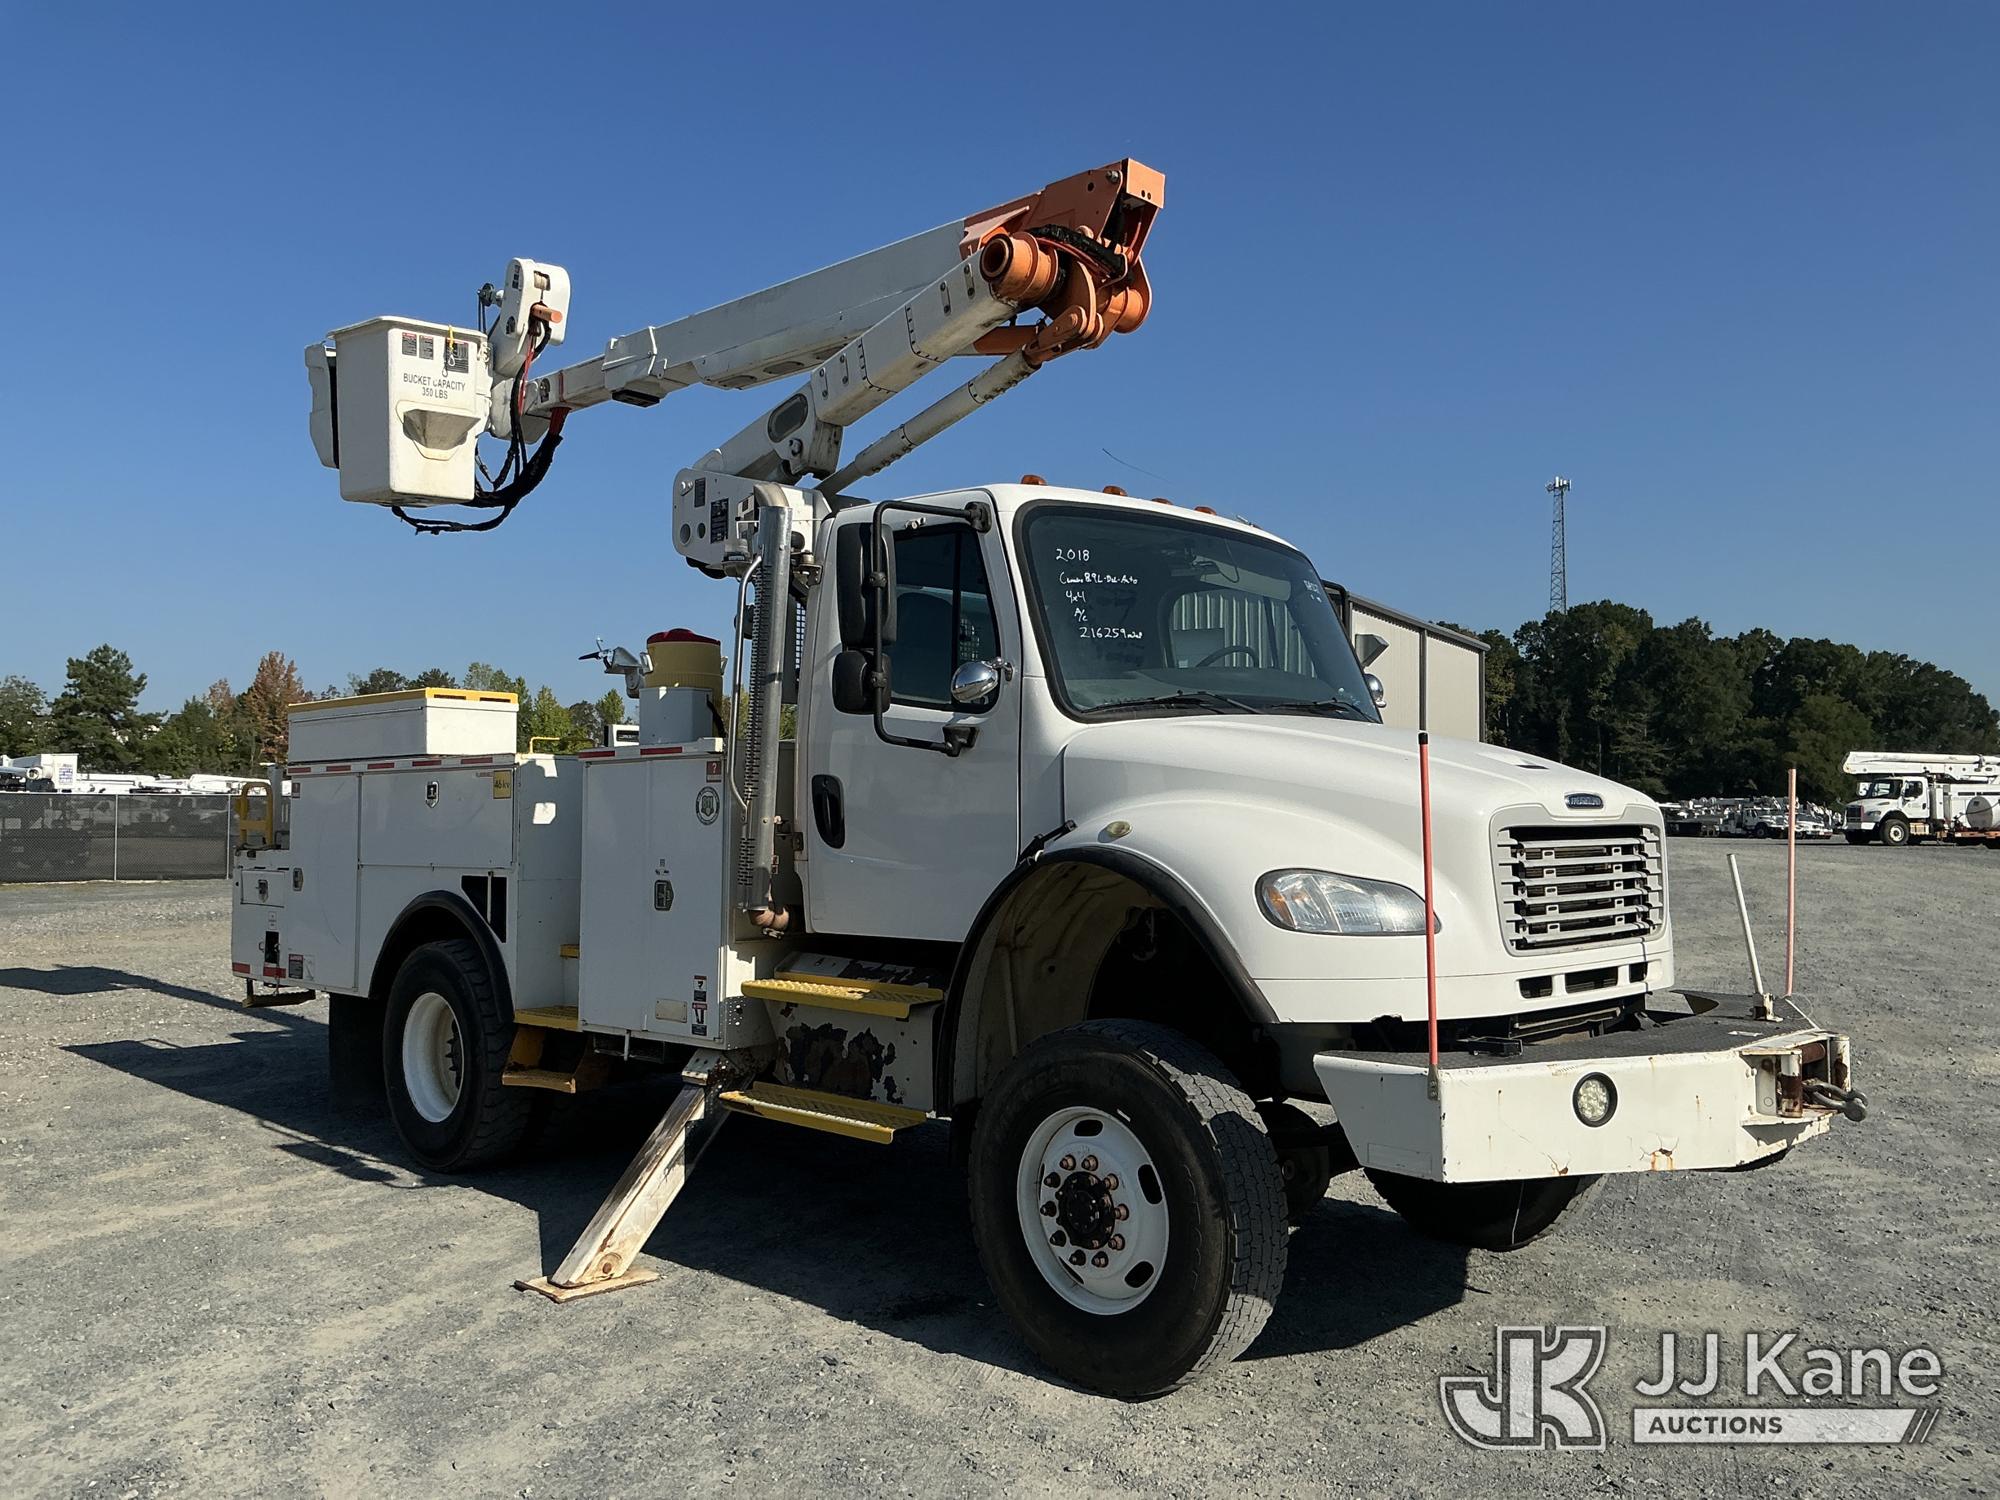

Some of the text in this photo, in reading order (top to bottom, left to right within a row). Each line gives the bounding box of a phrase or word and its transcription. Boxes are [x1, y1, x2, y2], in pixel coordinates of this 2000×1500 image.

[403, 372, 432, 386] BUCKET
[422, 387, 448, 399] 350 LBS
[1055, 548, 1090, 562] 2018
[1065, 590, 1086, 604] 4x4
